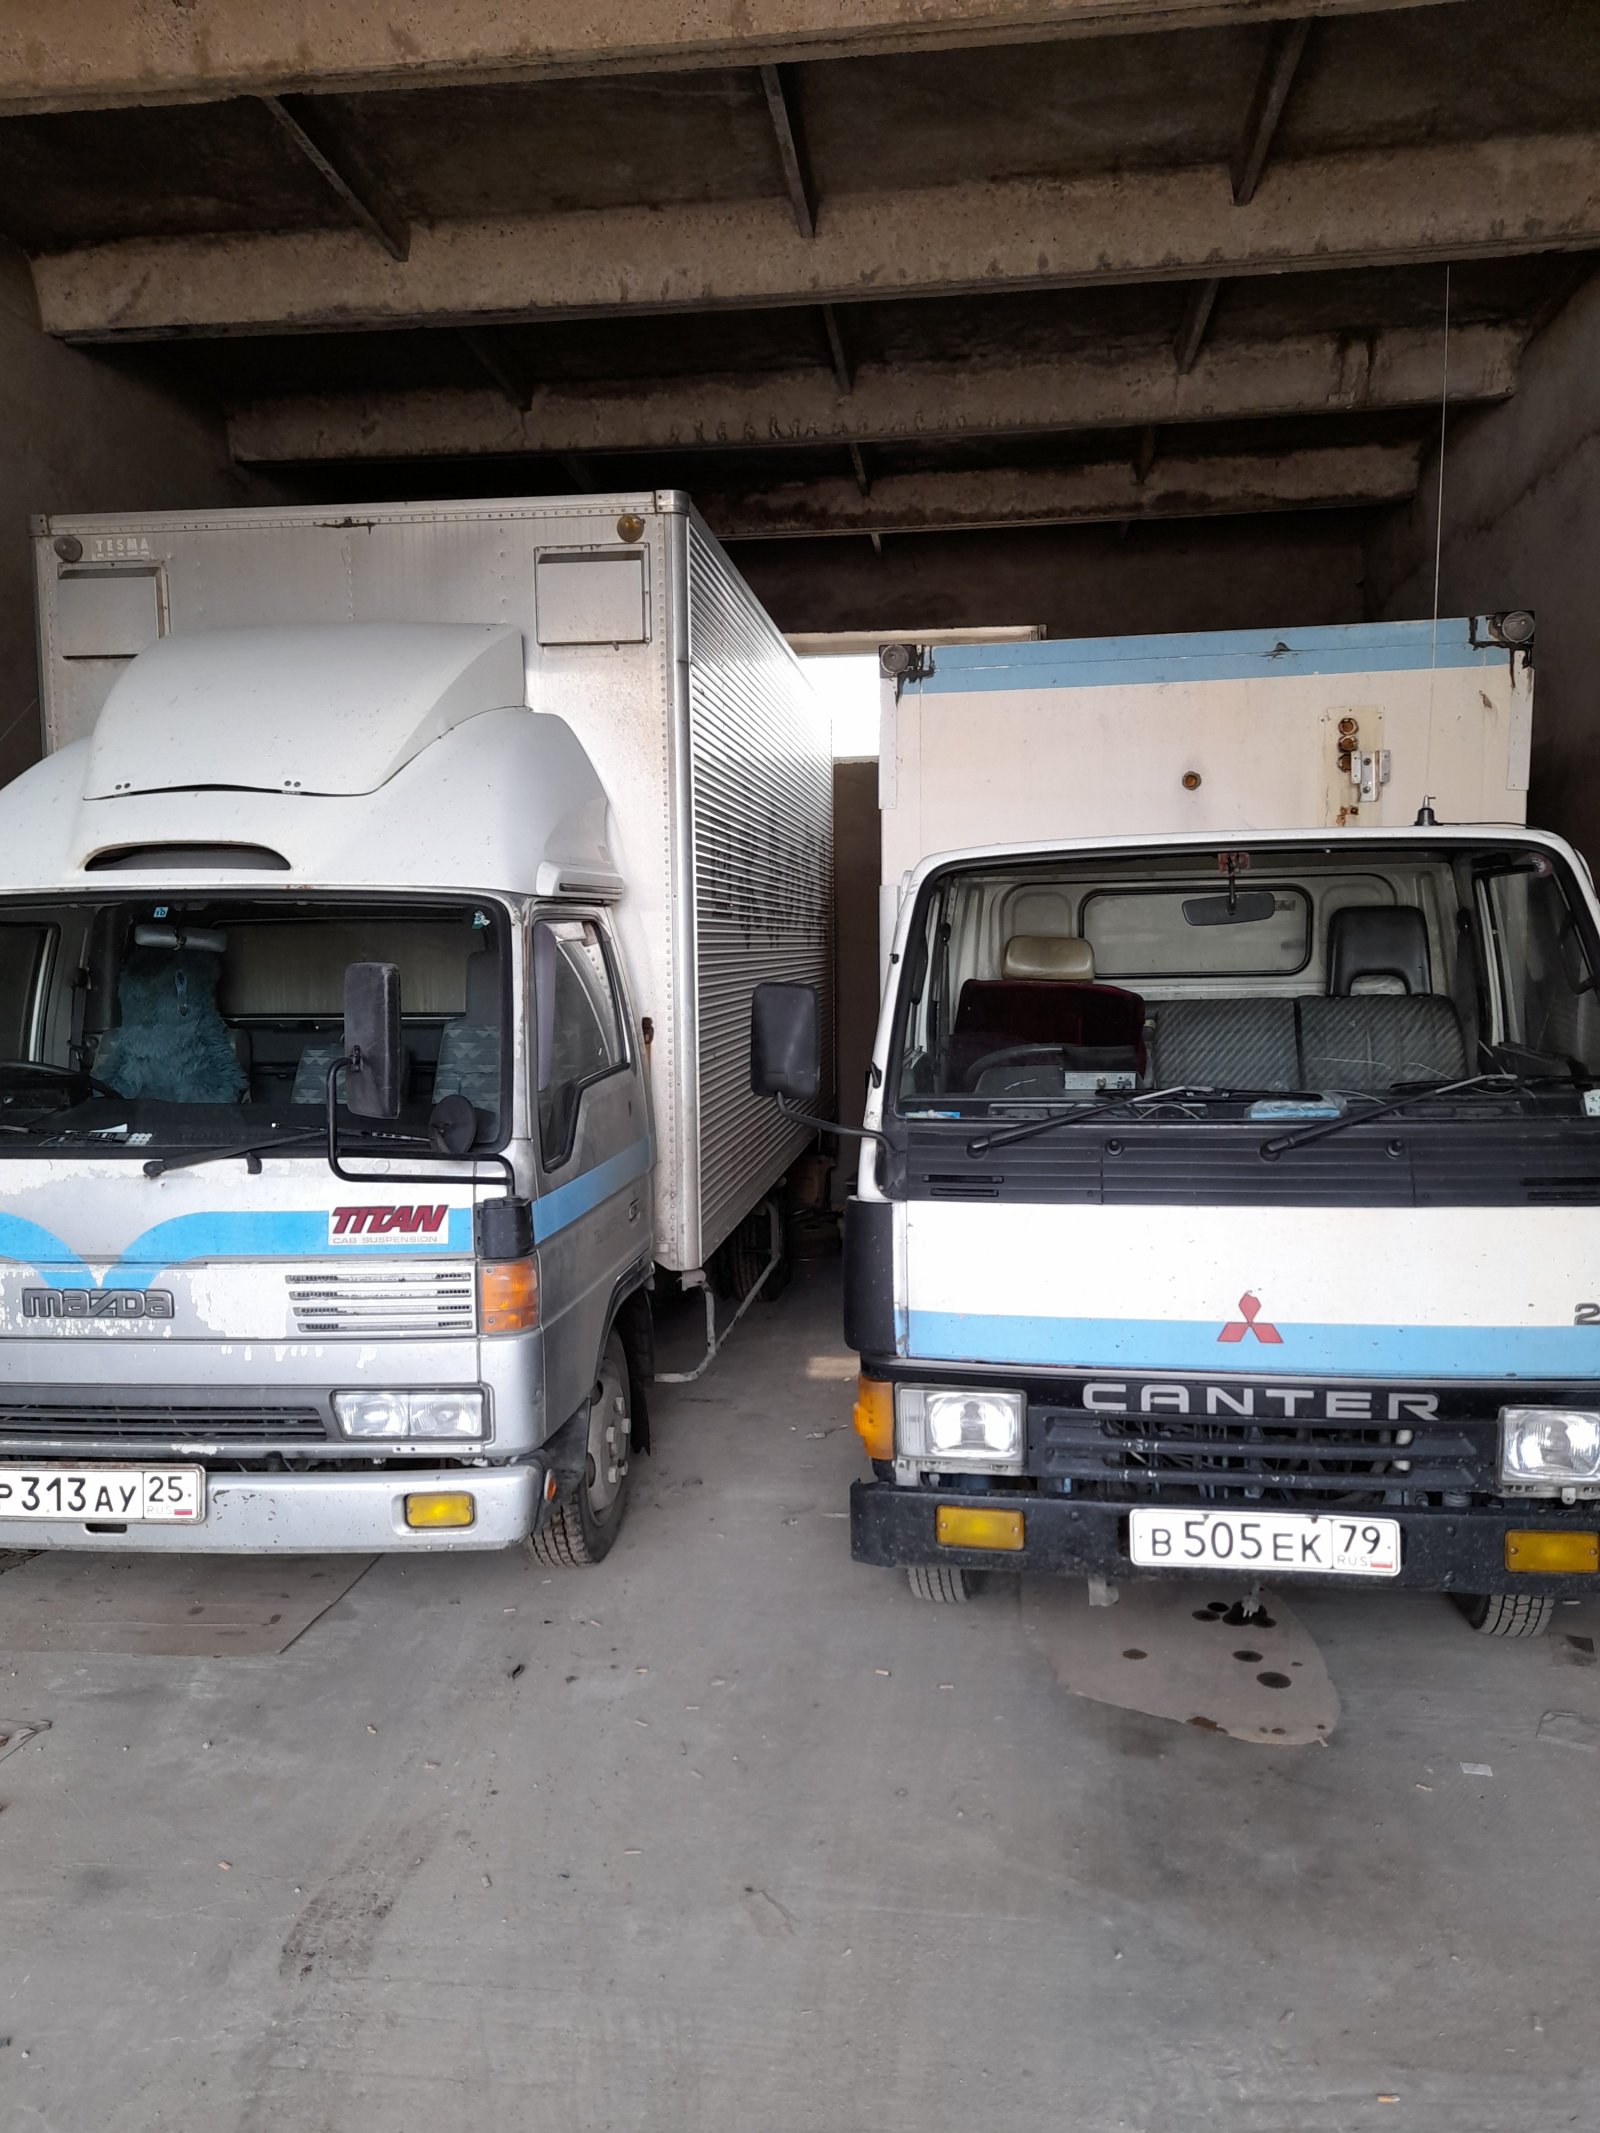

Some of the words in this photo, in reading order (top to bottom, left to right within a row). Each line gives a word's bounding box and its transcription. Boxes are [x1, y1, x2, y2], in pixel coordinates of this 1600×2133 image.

[332, 1205, 449, 1234] TITAN
[362, 1236, 438, 1244] SUSPENSION
[1083, 1383, 1439, 1420] CANTER
[148, 1476, 184, 1502] 25
[147, 1506, 173, 1515] RUS
[1339, 1524, 1381, 1555] 79
[1337, 1555, 1368, 1567] RUS
